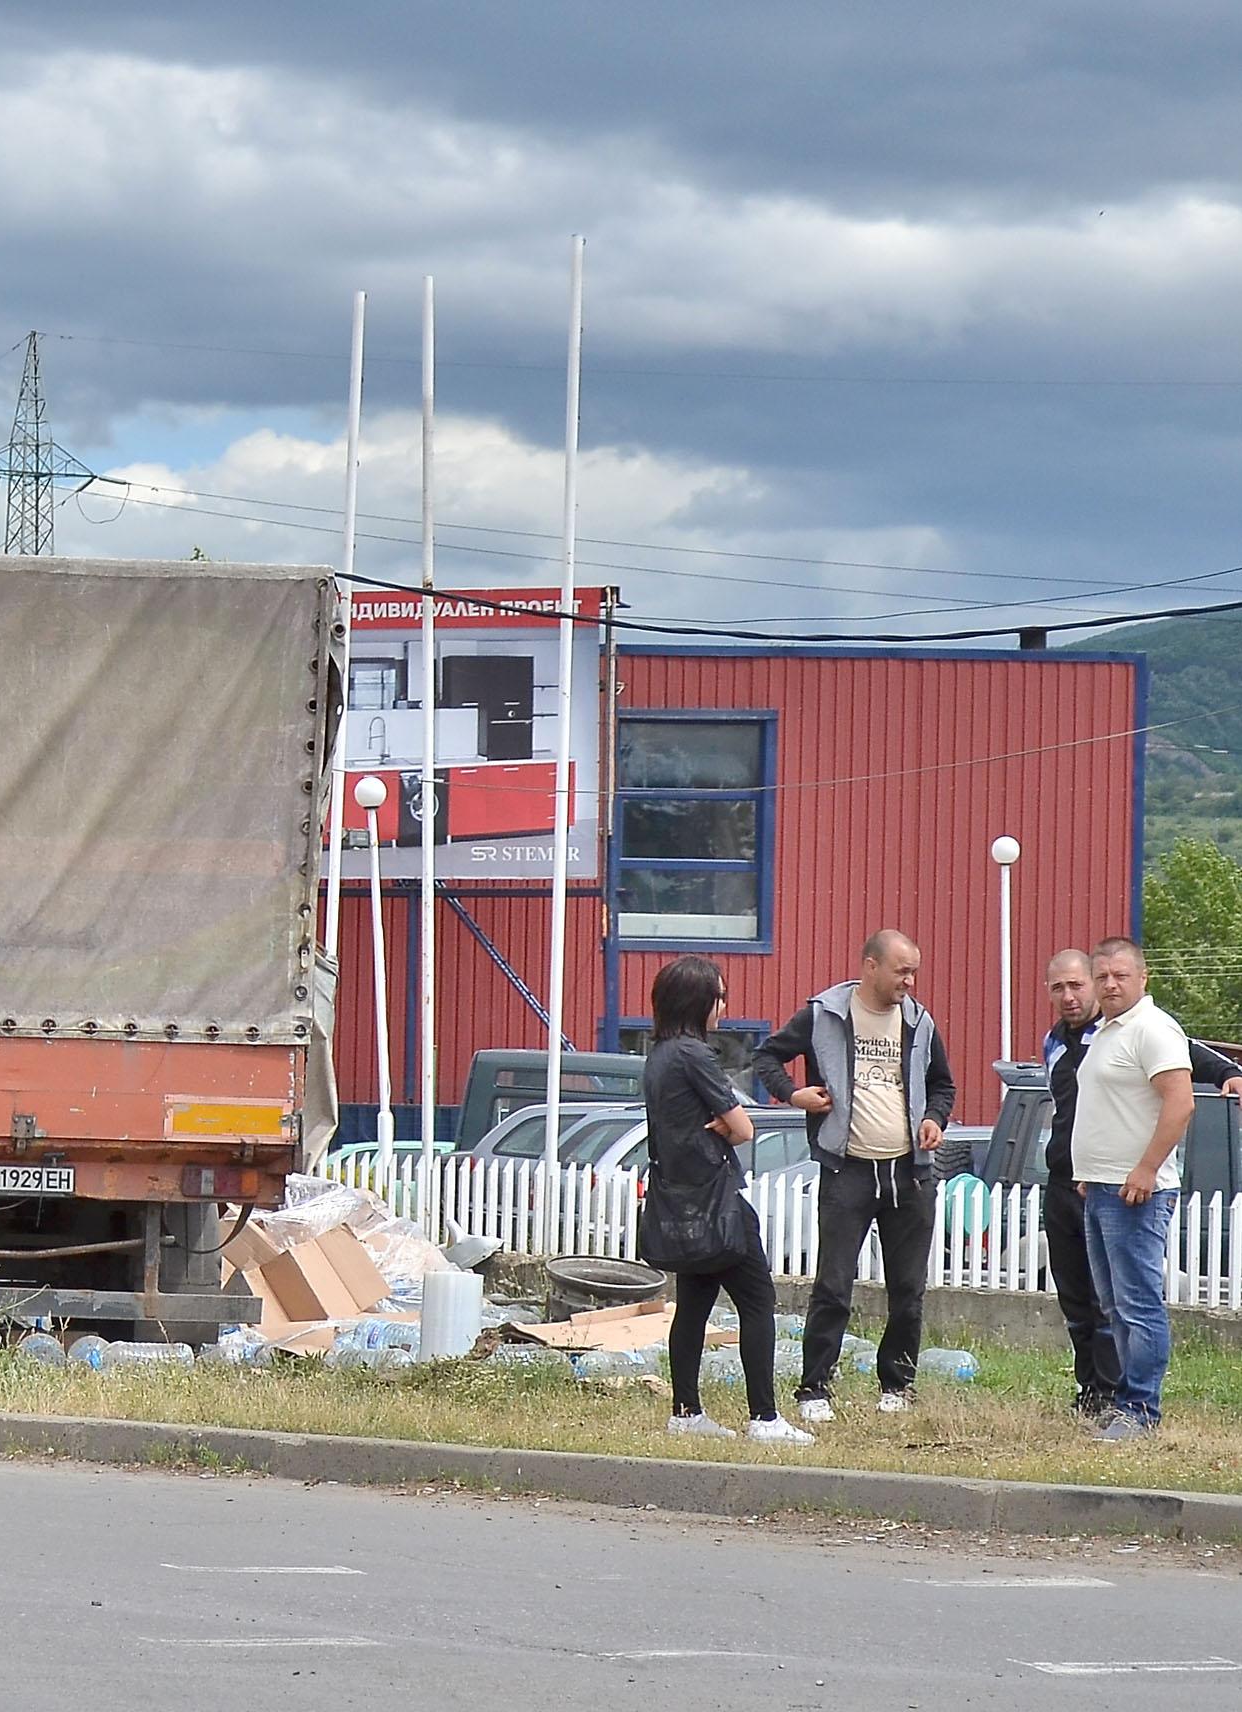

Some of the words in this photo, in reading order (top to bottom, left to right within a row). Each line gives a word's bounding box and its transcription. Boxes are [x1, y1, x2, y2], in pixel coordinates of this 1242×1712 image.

[502, 846, 580, 861] STEMR
[855, 1034, 891, 1047] Switch
[0, 1169, 42, 1188] 1929
